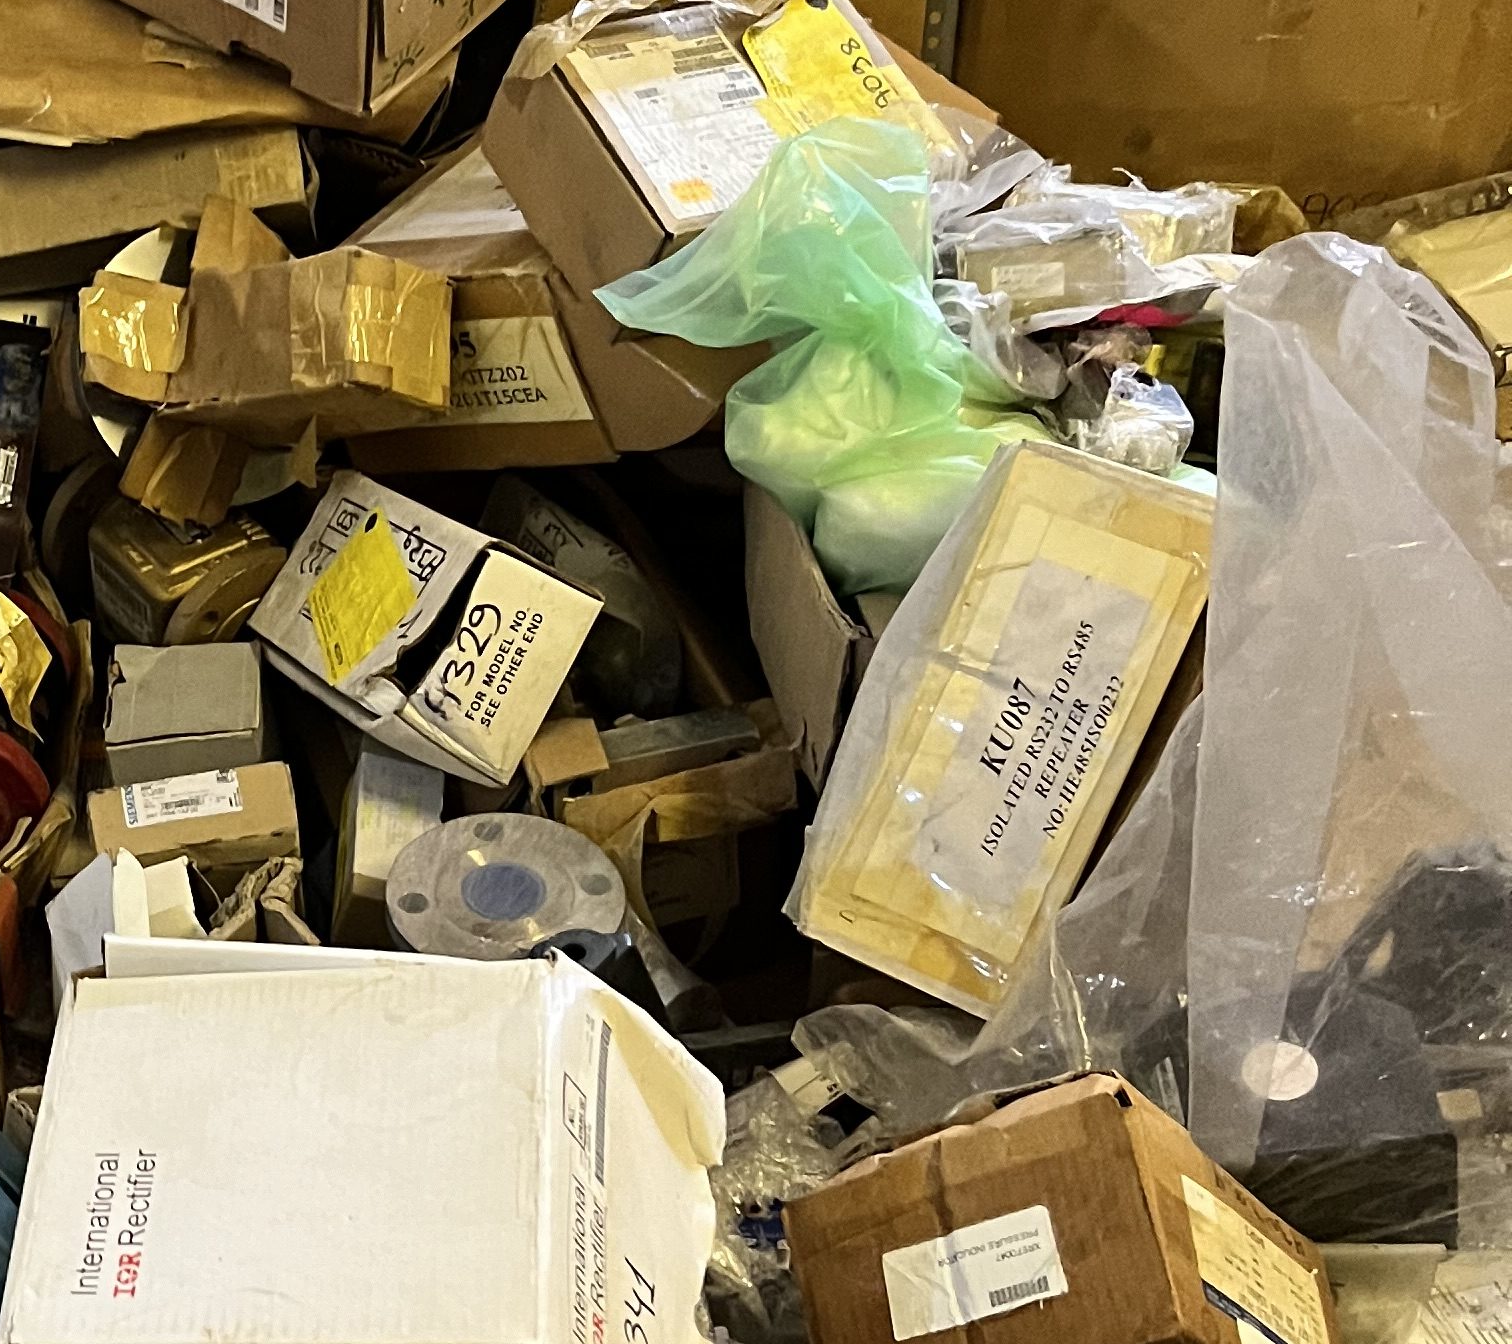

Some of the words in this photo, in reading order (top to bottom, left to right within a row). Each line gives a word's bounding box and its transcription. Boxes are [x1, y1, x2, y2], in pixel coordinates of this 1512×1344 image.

[464, 689, 486, 722] FOR
[483, 637, 515, 687] MODEL
[480, 698, 500, 728] SEE
[496, 647, 528, 695] OTHER
[522, 611, 544, 646] END
[978, 676, 1037, 778] KU087
[980, 761, 1033, 857] ISOLATED
[1024, 706, 1060, 761] RS232
[1049, 676, 1071, 706] TO
[1061, 619, 1095, 678] RS485
[1033, 696, 1091, 800] REPEATER
[70, 1152, 121, 1296] International
[117, 1147, 158, 1247] Rectifier
[589, 1194, 606, 1313] Rectifier
